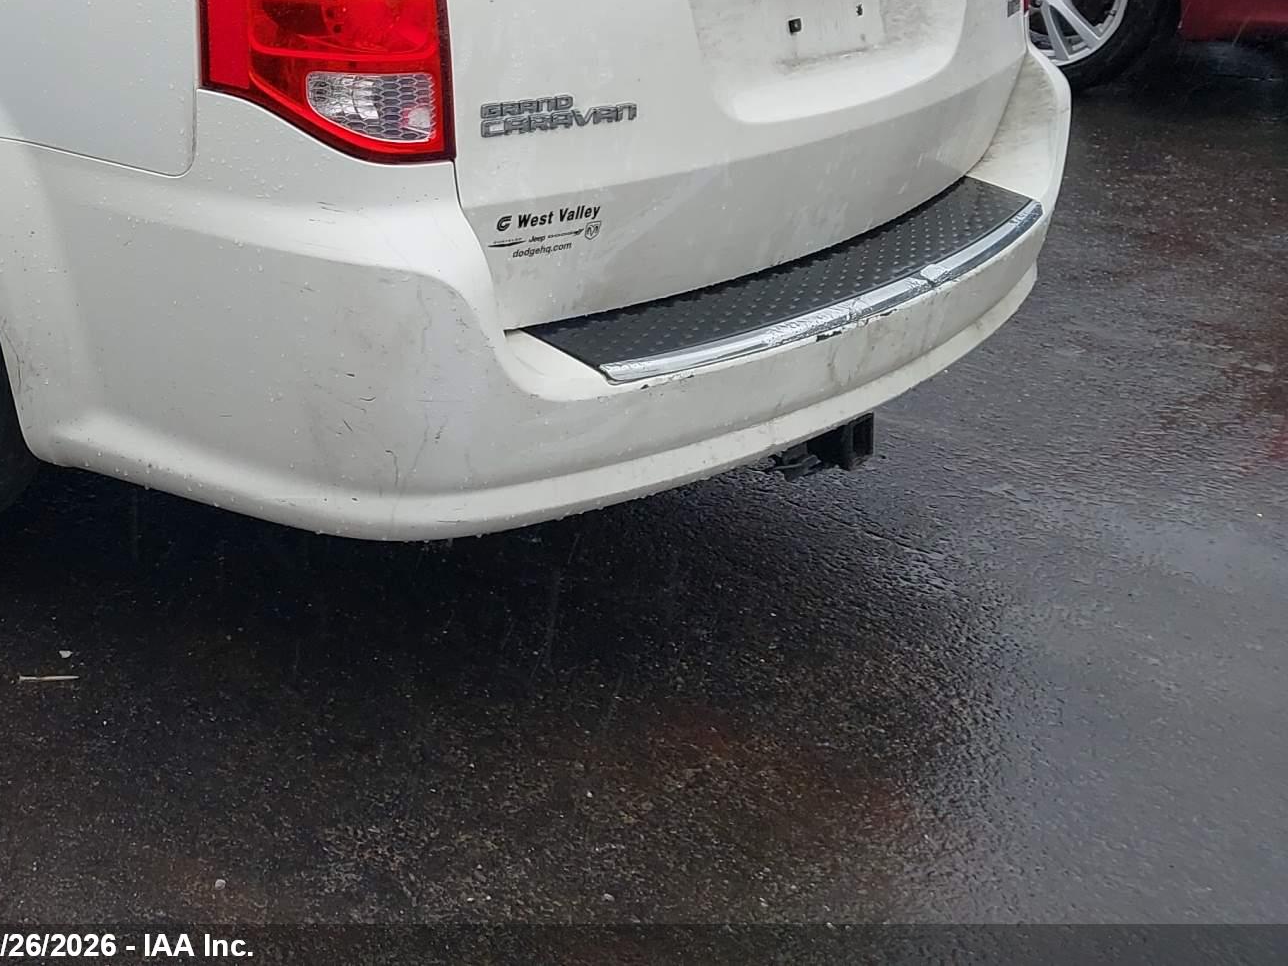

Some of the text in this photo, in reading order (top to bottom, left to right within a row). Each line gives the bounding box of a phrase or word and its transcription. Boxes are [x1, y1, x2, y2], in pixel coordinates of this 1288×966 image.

[480, 95, 573, 119] GRAND
[480, 103, 637, 138] CARAVAN
[518, 211, 554, 229] West
[559, 205, 600, 222] Valley
[512, 242, 572, 258] dodgehq.com
